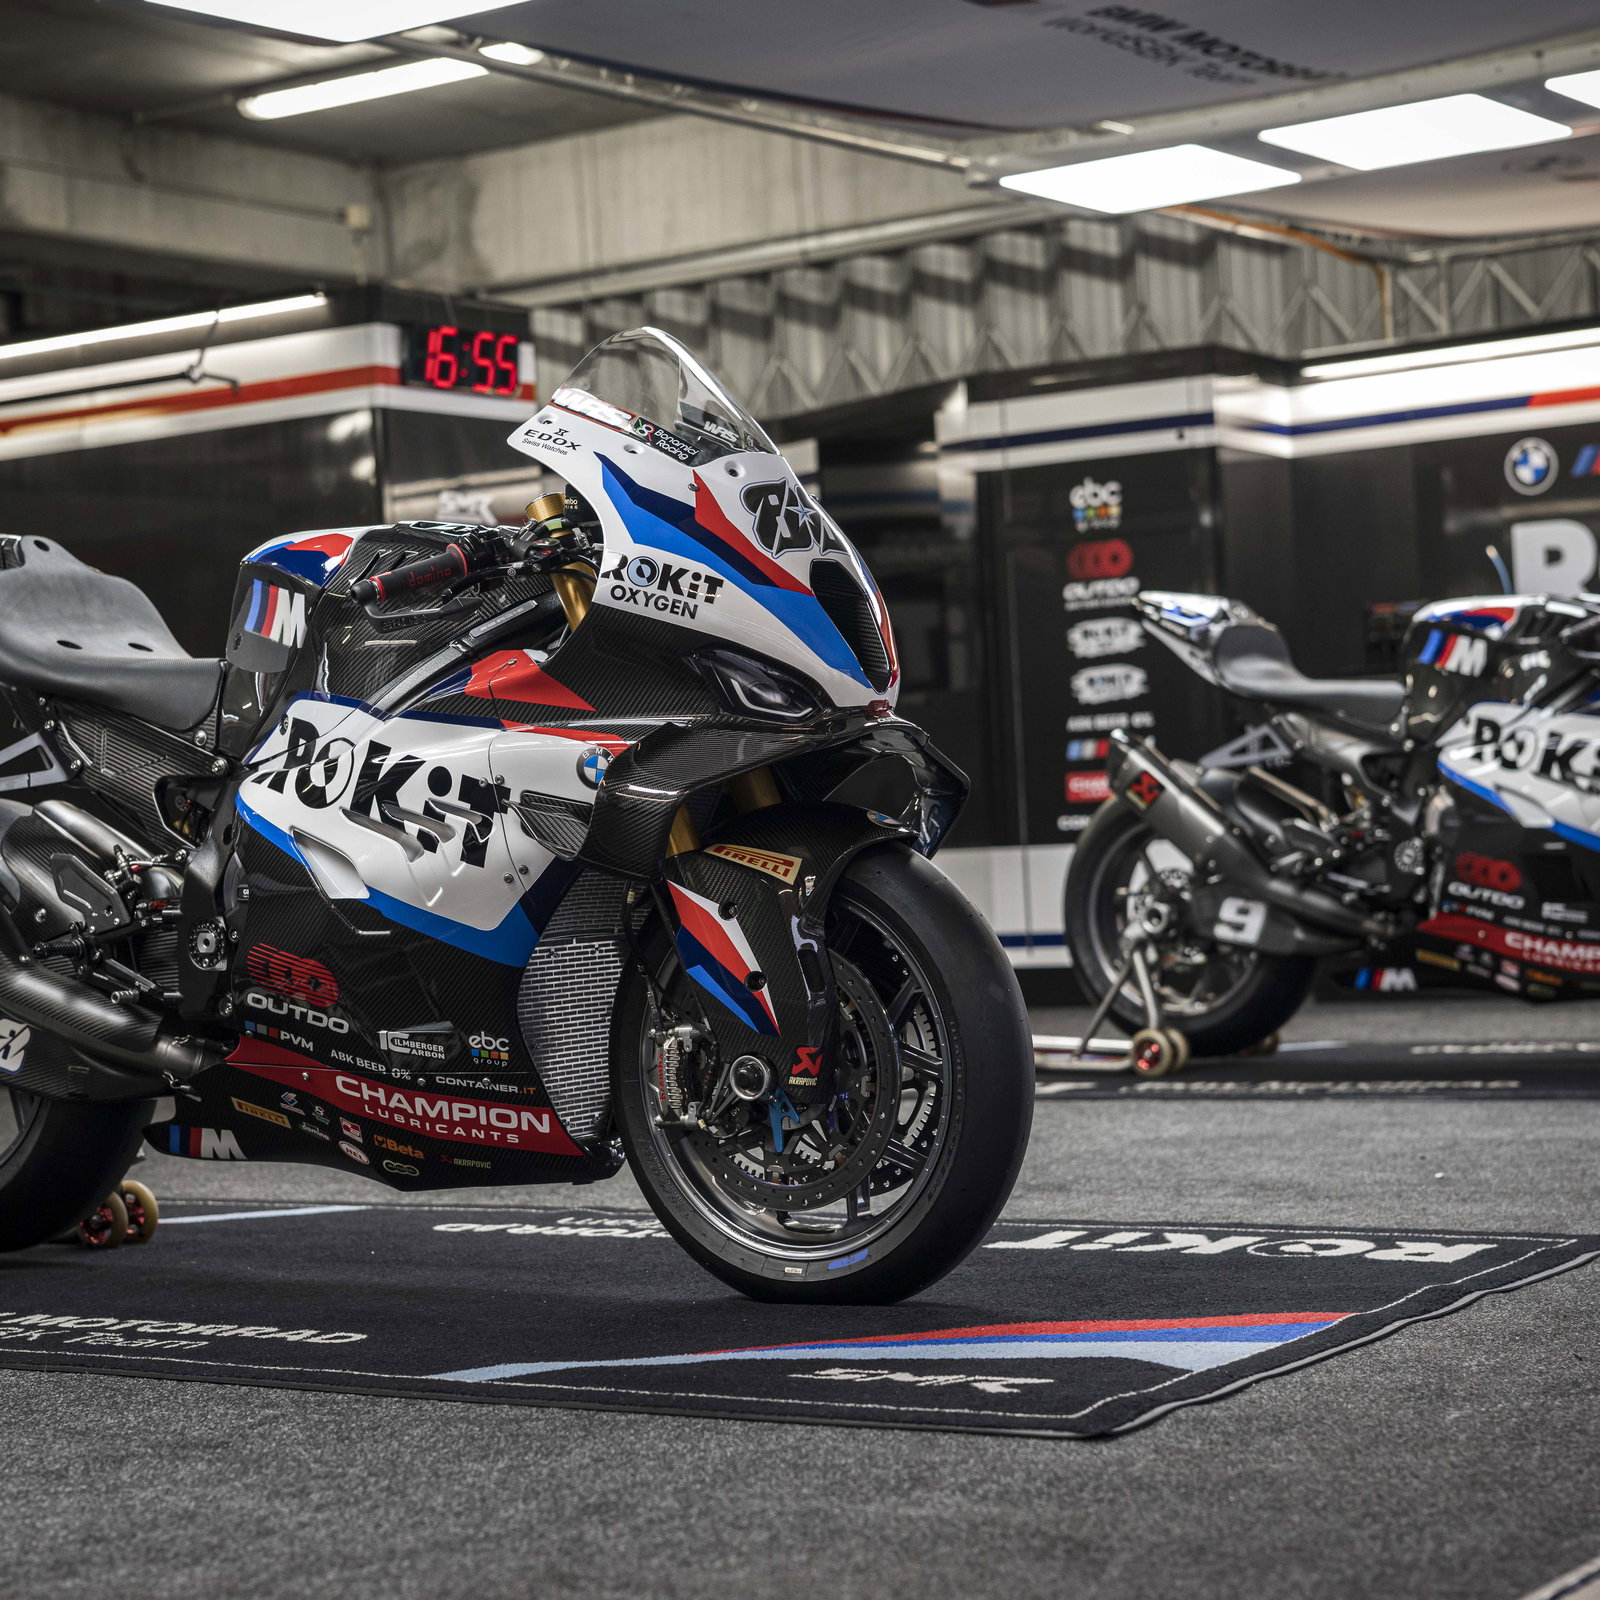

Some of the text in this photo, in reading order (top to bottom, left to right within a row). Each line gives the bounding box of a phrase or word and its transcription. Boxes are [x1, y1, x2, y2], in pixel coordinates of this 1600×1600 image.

[425, 326, 518, 395] 16:55
[524, 428, 581, 451] EDOX
[703, 420, 740, 442] WRS
[522, 438, 568, 456] Swiss Watches
[656, 439, 689, 460] Racing
[408, 565, 452, 587] domino
[610, 584, 698, 620] OXYGEN
[714, 846, 794, 877] PIRELLI
[1213, 897, 1265, 944] 9
[246, 992, 350, 1034] OUTDO
[280, 1030, 314, 1052] PVM
[468, 1031, 509, 1052] ebc
[330, 1049, 412, 1081] ABK BEER 0%
[473, 1056, 508, 1068] group
[234, 1099, 286, 1126] PIRELLI
[335, 1075, 550, 1134] CHAMPION
[364, 1104, 519, 1144] LUBRICANTS
[386, 1138, 425, 1160] Beta
[1, 1313, 368, 1345] MOTORRAD
[63, 1331, 209, 1349] Team
